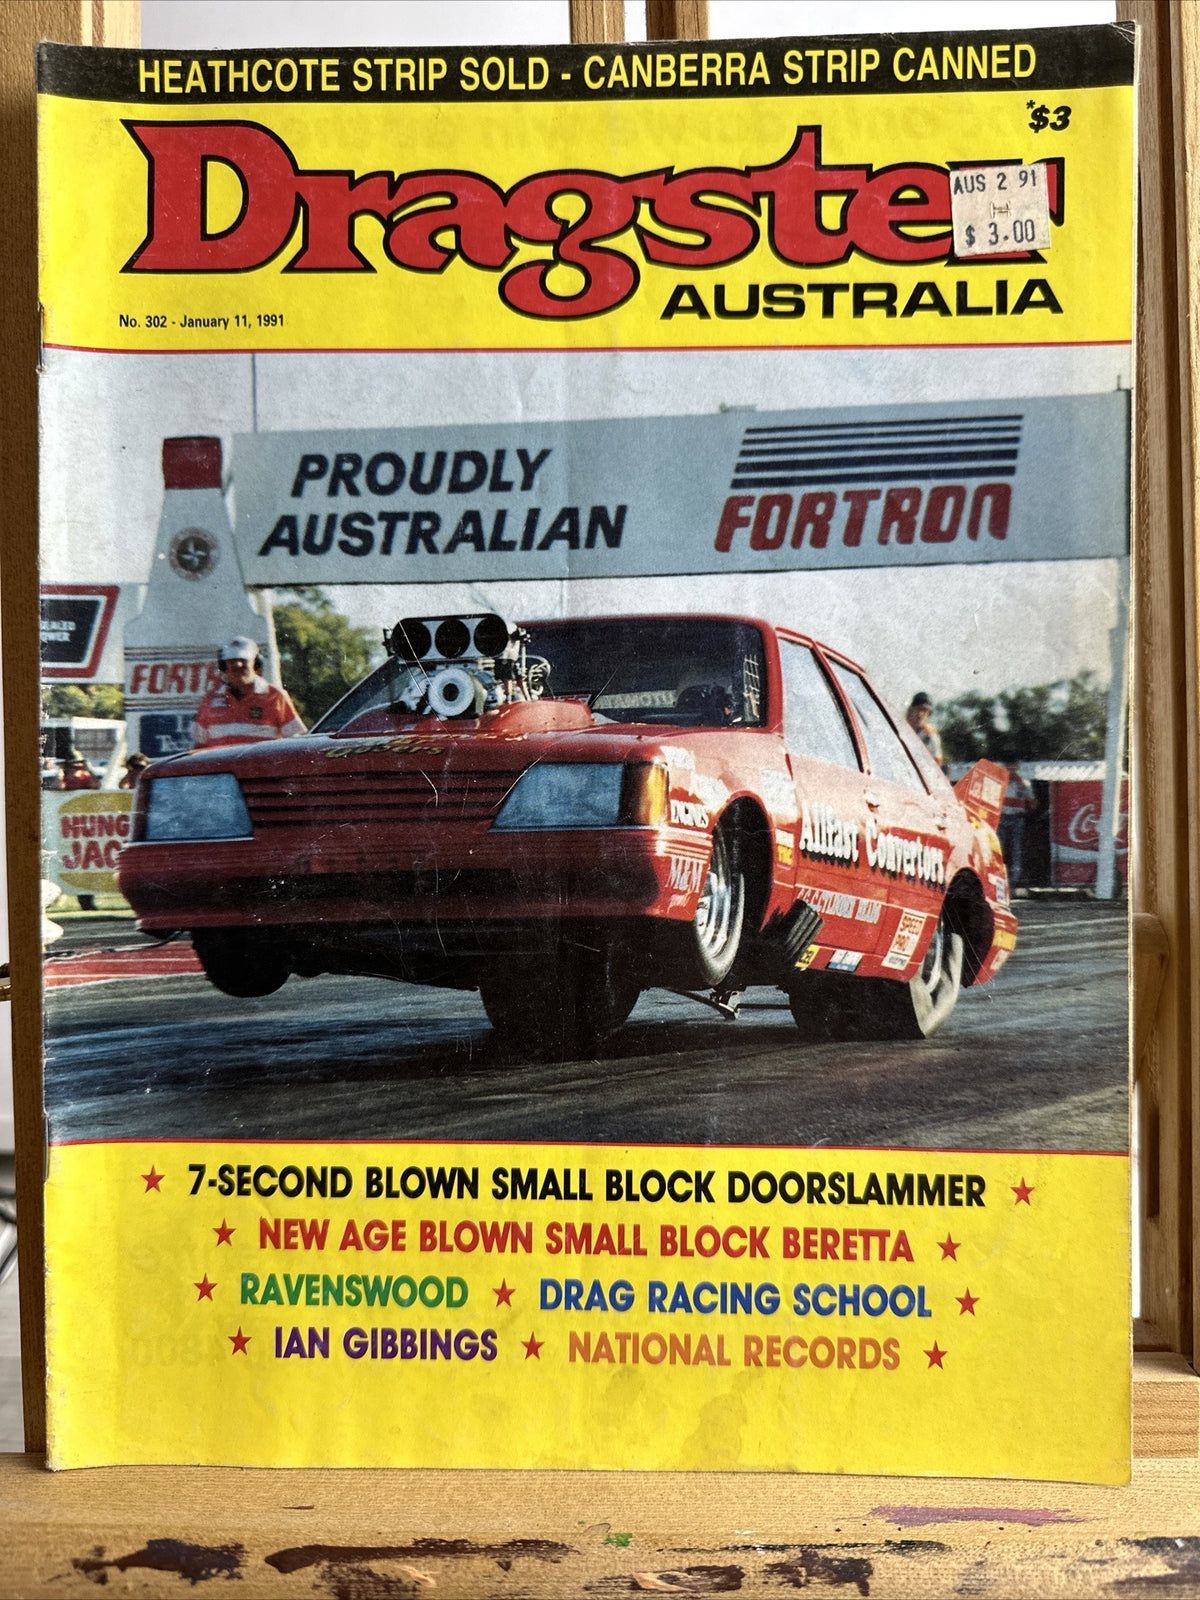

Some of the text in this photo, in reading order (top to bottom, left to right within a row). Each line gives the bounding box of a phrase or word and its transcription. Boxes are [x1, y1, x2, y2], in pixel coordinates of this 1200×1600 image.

[139, 57, 339, 94] HEATHCOTE
[352, 56, 447, 92] STRIP
[460, 55, 549, 92] SOLD
[583, 51, 771, 90] CANBERRA
[783, 48, 880, 85] STRIP
[893, 43, 1036, 82] CANNED
[953, 169, 1037, 195] AUS 2 91
[988, 218, 1036, 246] 3.00
[660, 279, 1063, 320] AUSTRALIA
[119, 314, 141, 328] No.
[145, 315, 168, 328] 302
[180, 315, 230, 330] January
[234, 314, 252, 328] 11,
[256, 314, 285, 327] 1991
[291, 448, 552, 498] PROUDLY
[258, 504, 627, 557] AUSTRALIAN
[716, 483, 1011, 552] FORTRON
[61, 814, 130, 838] HUNG
[188, 1163, 986, 1207] 7-SECOND BLOWN SMALL BLOCK DOORSLAMMER
[259, 1217, 915, 1262] NEW AGE BLOWN SMALL BLOCK BERETTA
[240, 1272, 932, 1318] RAVENSWOOD DRAG RACING SCHOOL
[275, 1326, 900, 1370] IAN GIBBINGS NATIONAL RECORDS
